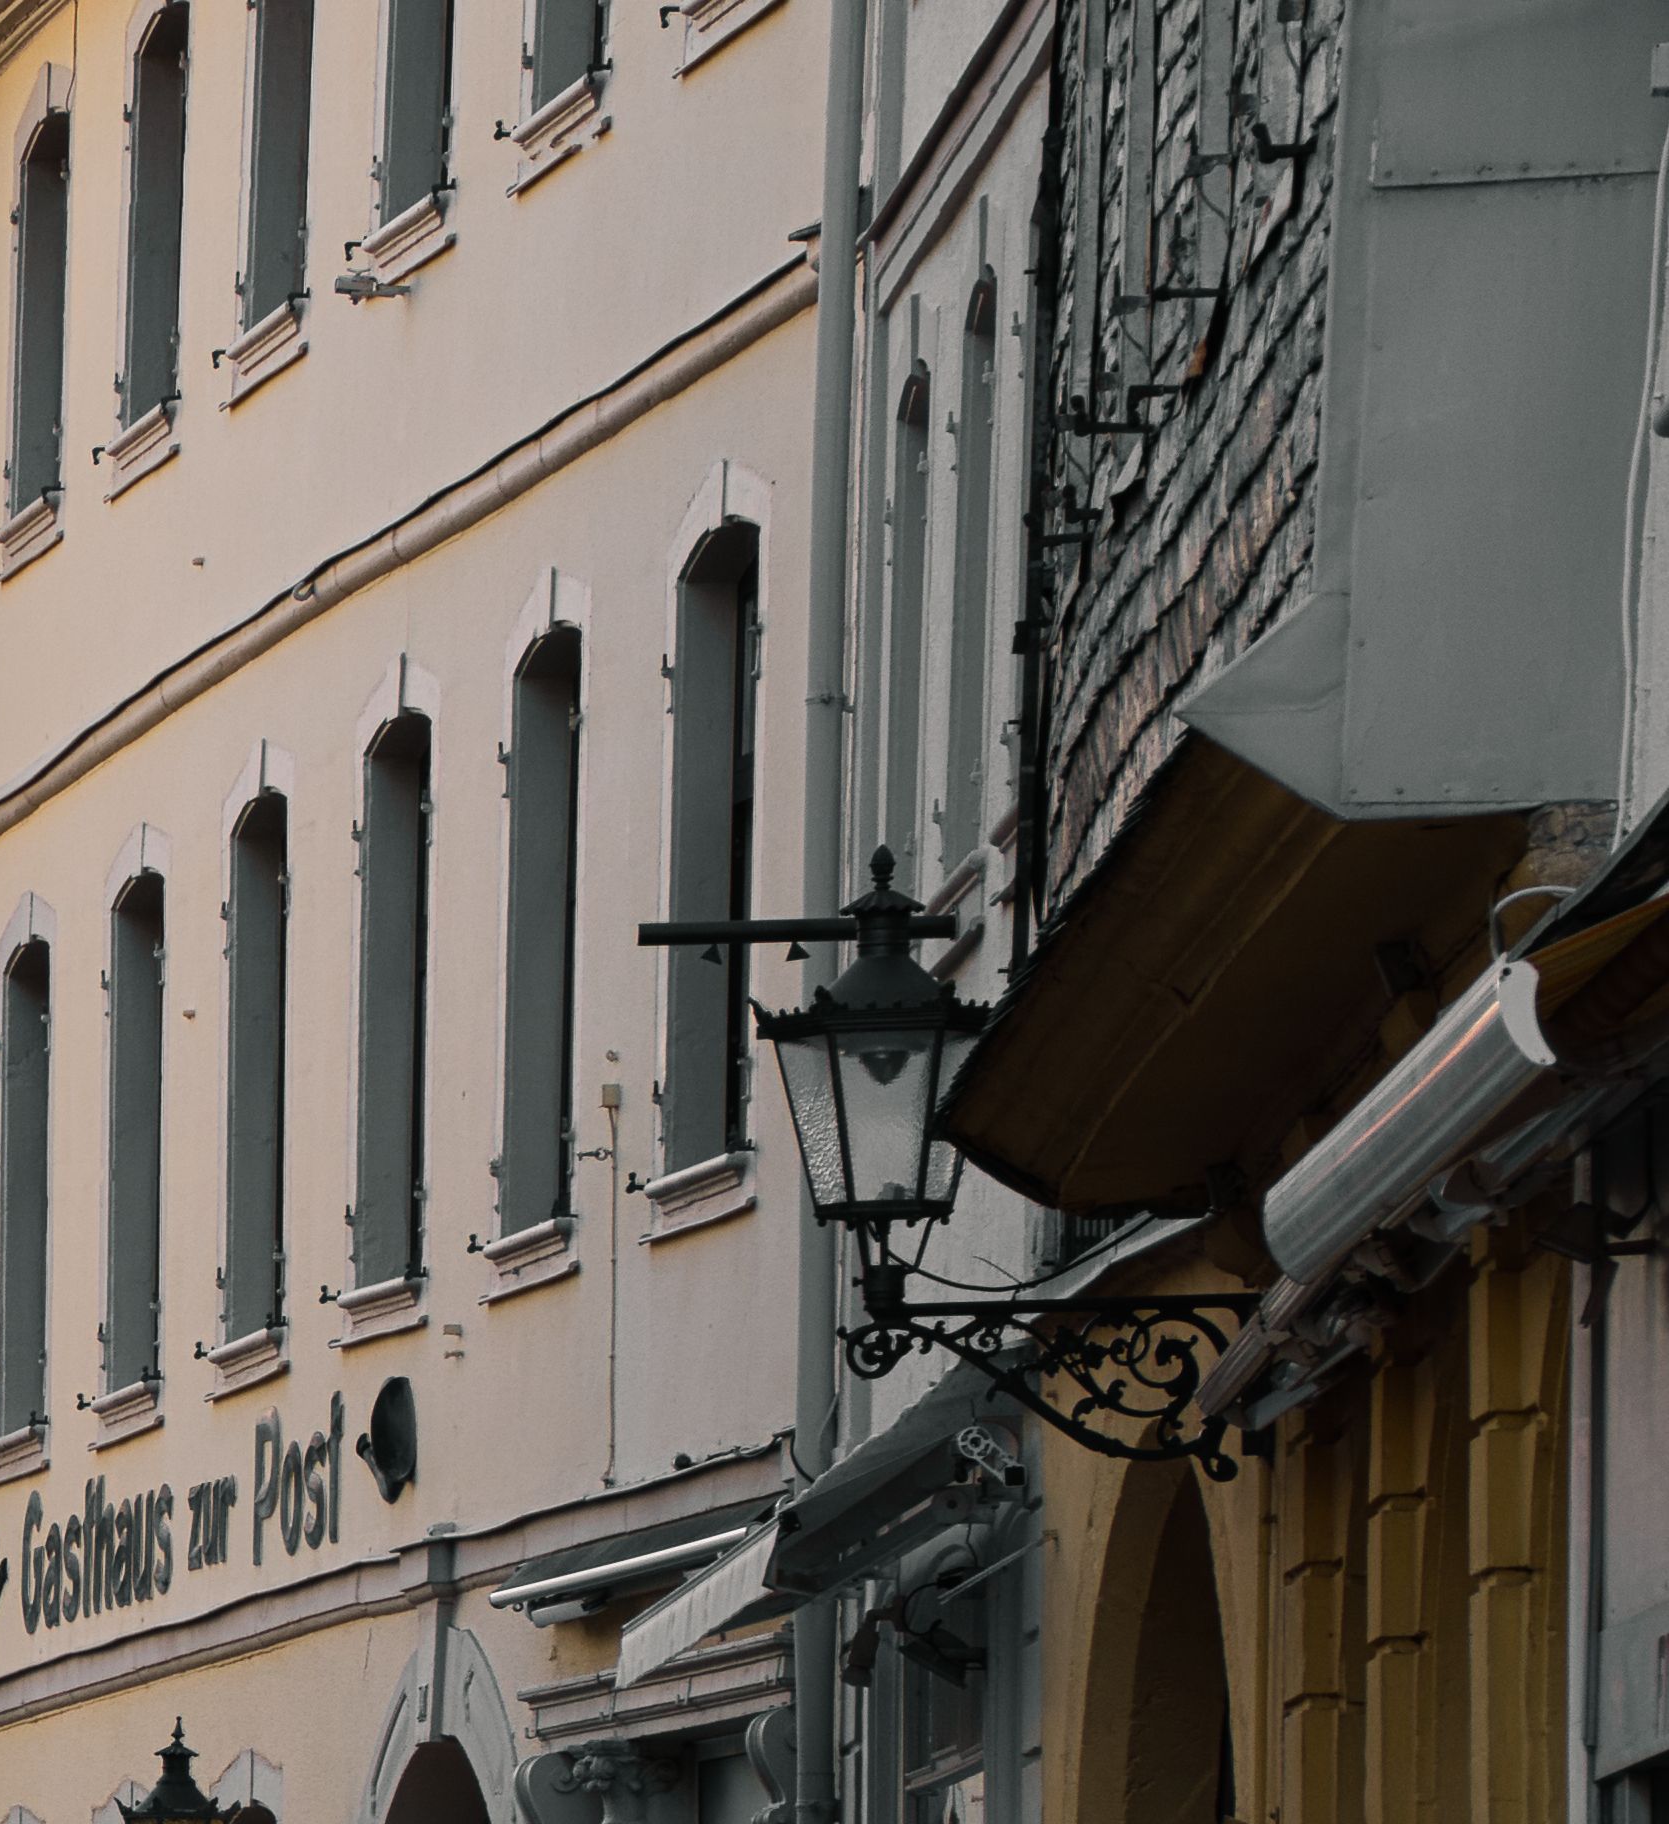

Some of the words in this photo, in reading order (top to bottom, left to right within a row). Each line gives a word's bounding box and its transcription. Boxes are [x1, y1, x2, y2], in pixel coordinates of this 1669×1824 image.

[22, 1475, 174, 1634] Gasthaus
[188, 1474, 237, 1572] zur
[253, 1390, 345, 1566] Post
